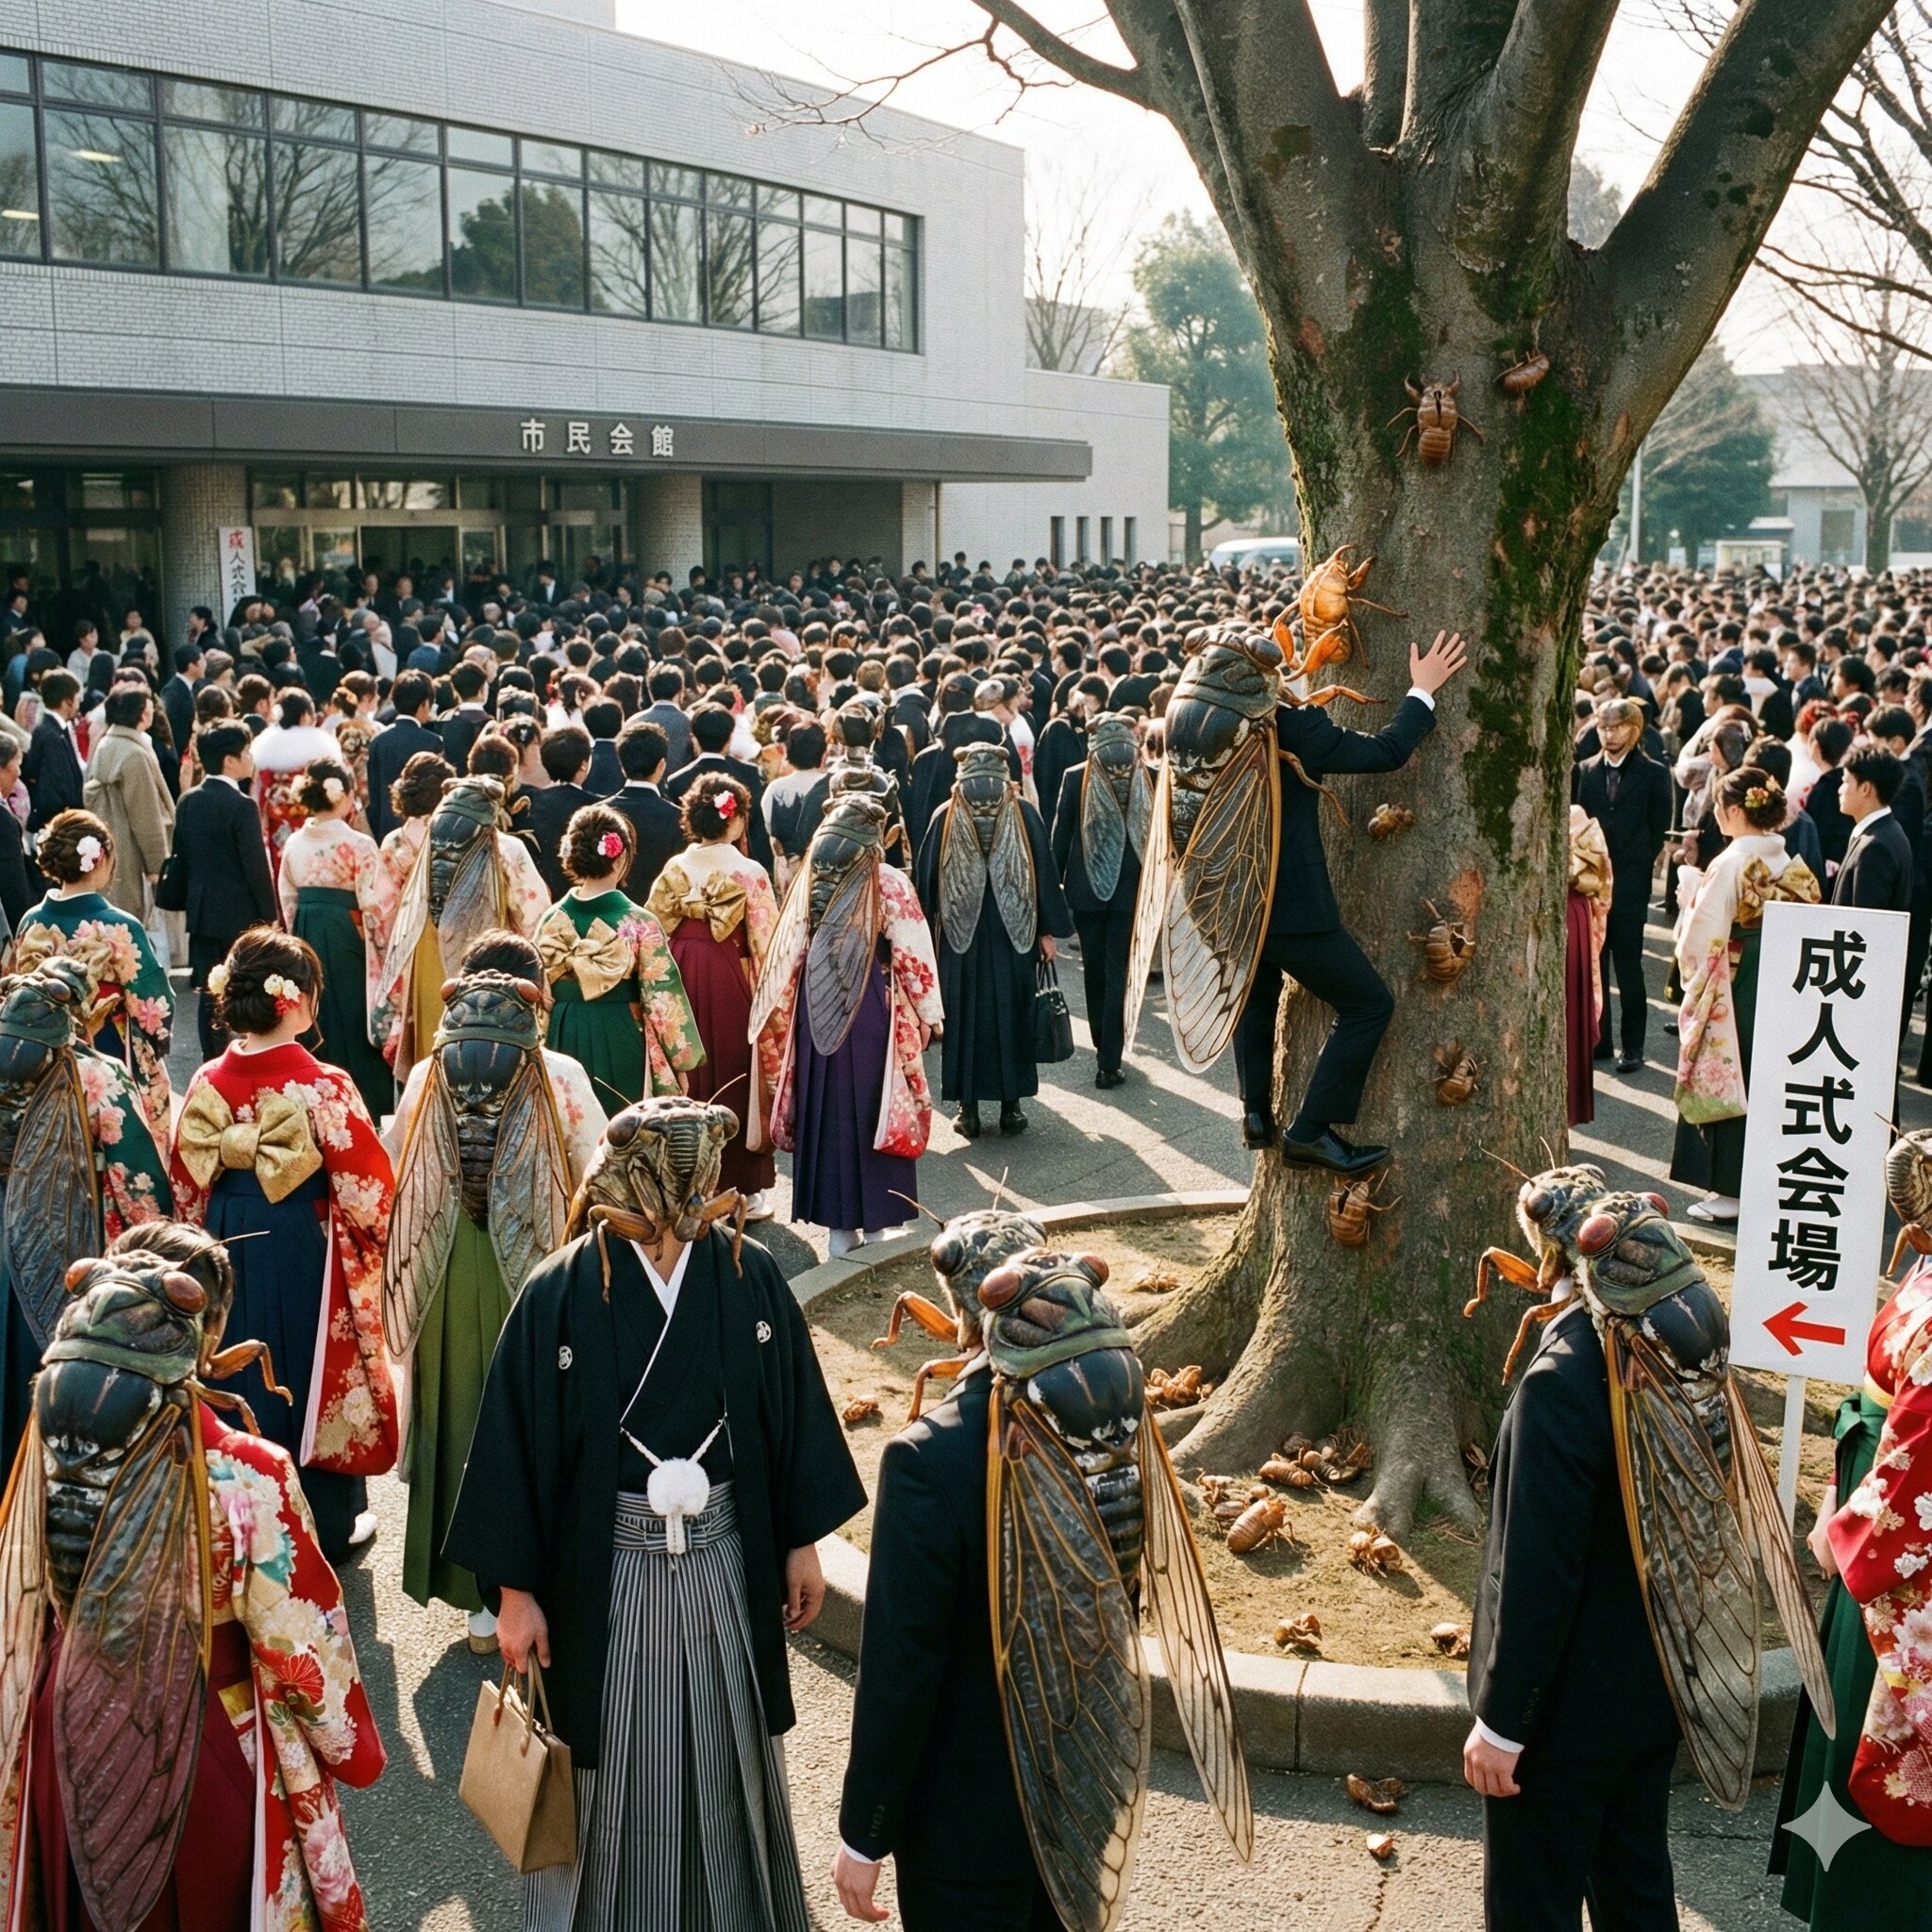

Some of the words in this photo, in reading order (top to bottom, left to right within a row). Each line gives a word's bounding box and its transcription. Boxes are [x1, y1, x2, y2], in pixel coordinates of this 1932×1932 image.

[521, 418, 674, 457] 市民会館
[229, 529, 246, 603] 成人式会
[1768, 929, 1867, 1291] 成人式会場
